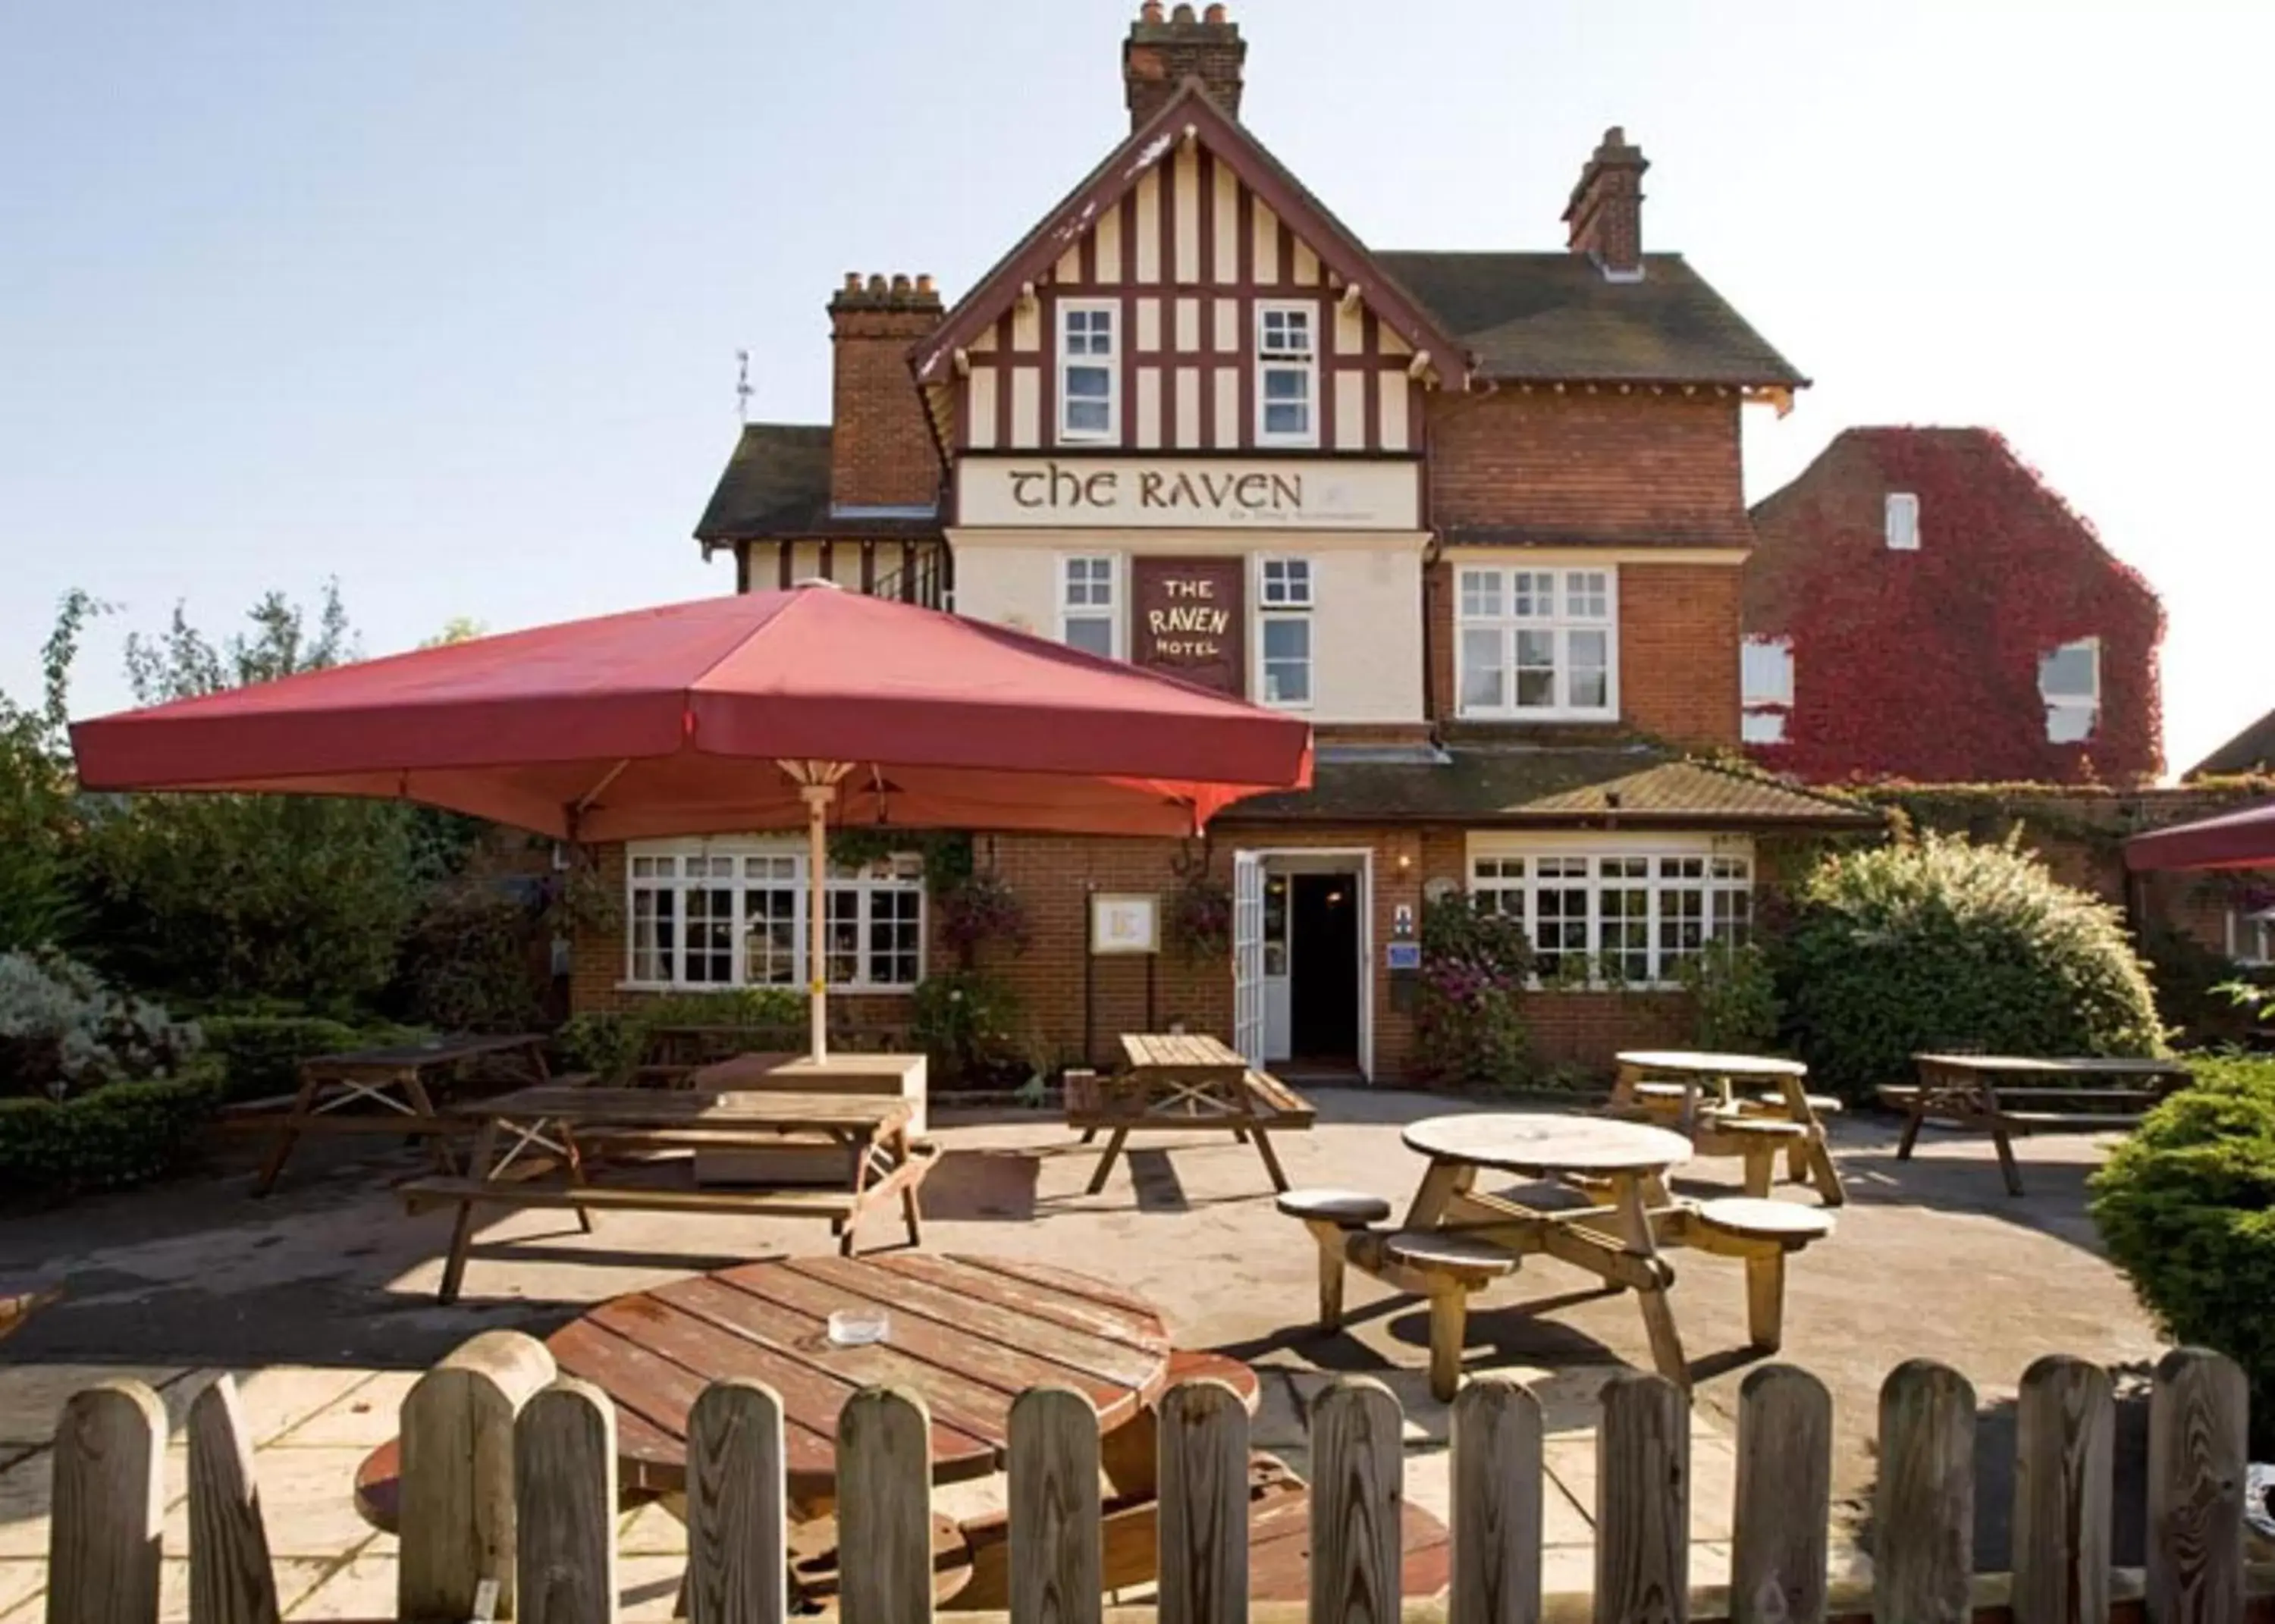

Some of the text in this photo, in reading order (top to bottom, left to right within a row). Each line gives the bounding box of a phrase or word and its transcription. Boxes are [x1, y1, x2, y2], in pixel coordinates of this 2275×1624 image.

[1138, 470, 1302, 509] RAVEN
[1163, 579, 1215, 599] THE
[1148, 606, 1230, 635] RAVEN
[1156, 639, 1221, 657] HOTEL
